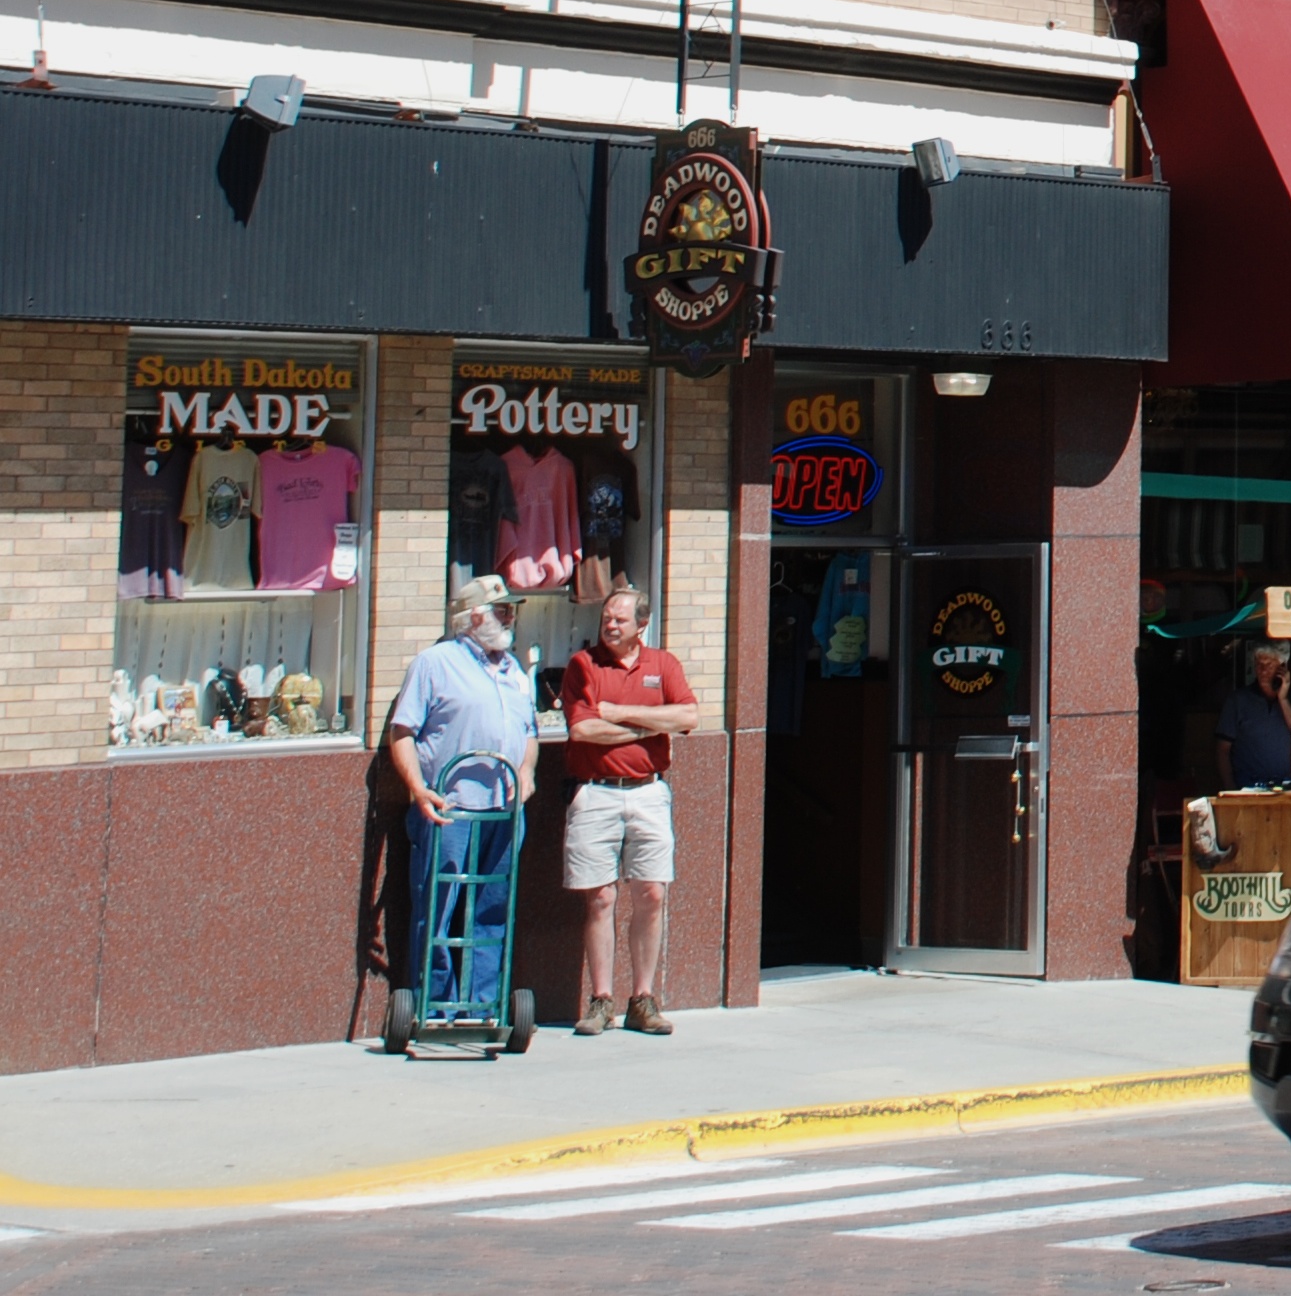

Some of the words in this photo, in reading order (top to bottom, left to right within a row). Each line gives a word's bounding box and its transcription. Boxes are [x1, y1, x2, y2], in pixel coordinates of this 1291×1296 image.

[688, 127, 716, 148] 666
[643, 162, 748, 237] DEADWOOD
[635, 248, 745, 279] GIFT
[655, 284, 729, 321] SHOPPE
[981, 318, 1032, 352] 666
[134, 355, 233, 387] South
[243, 358, 352, 389] Dakota
[459, 364, 573, 381] CRAFTSMAN
[590, 369, 642, 383] MADE
[159, 391, 331, 437] MADE
[461, 384, 640, 450] Pottery
[786, 394, 861, 435] 666
[771, 455, 867, 512] OPEN
[932, 592, 1006, 636] DEADWOOD
[932, 646, 1004, 666] GIFT
[942, 670, 994, 694] SHOPPE
[1224, 901, 1263, 918] TOURS
